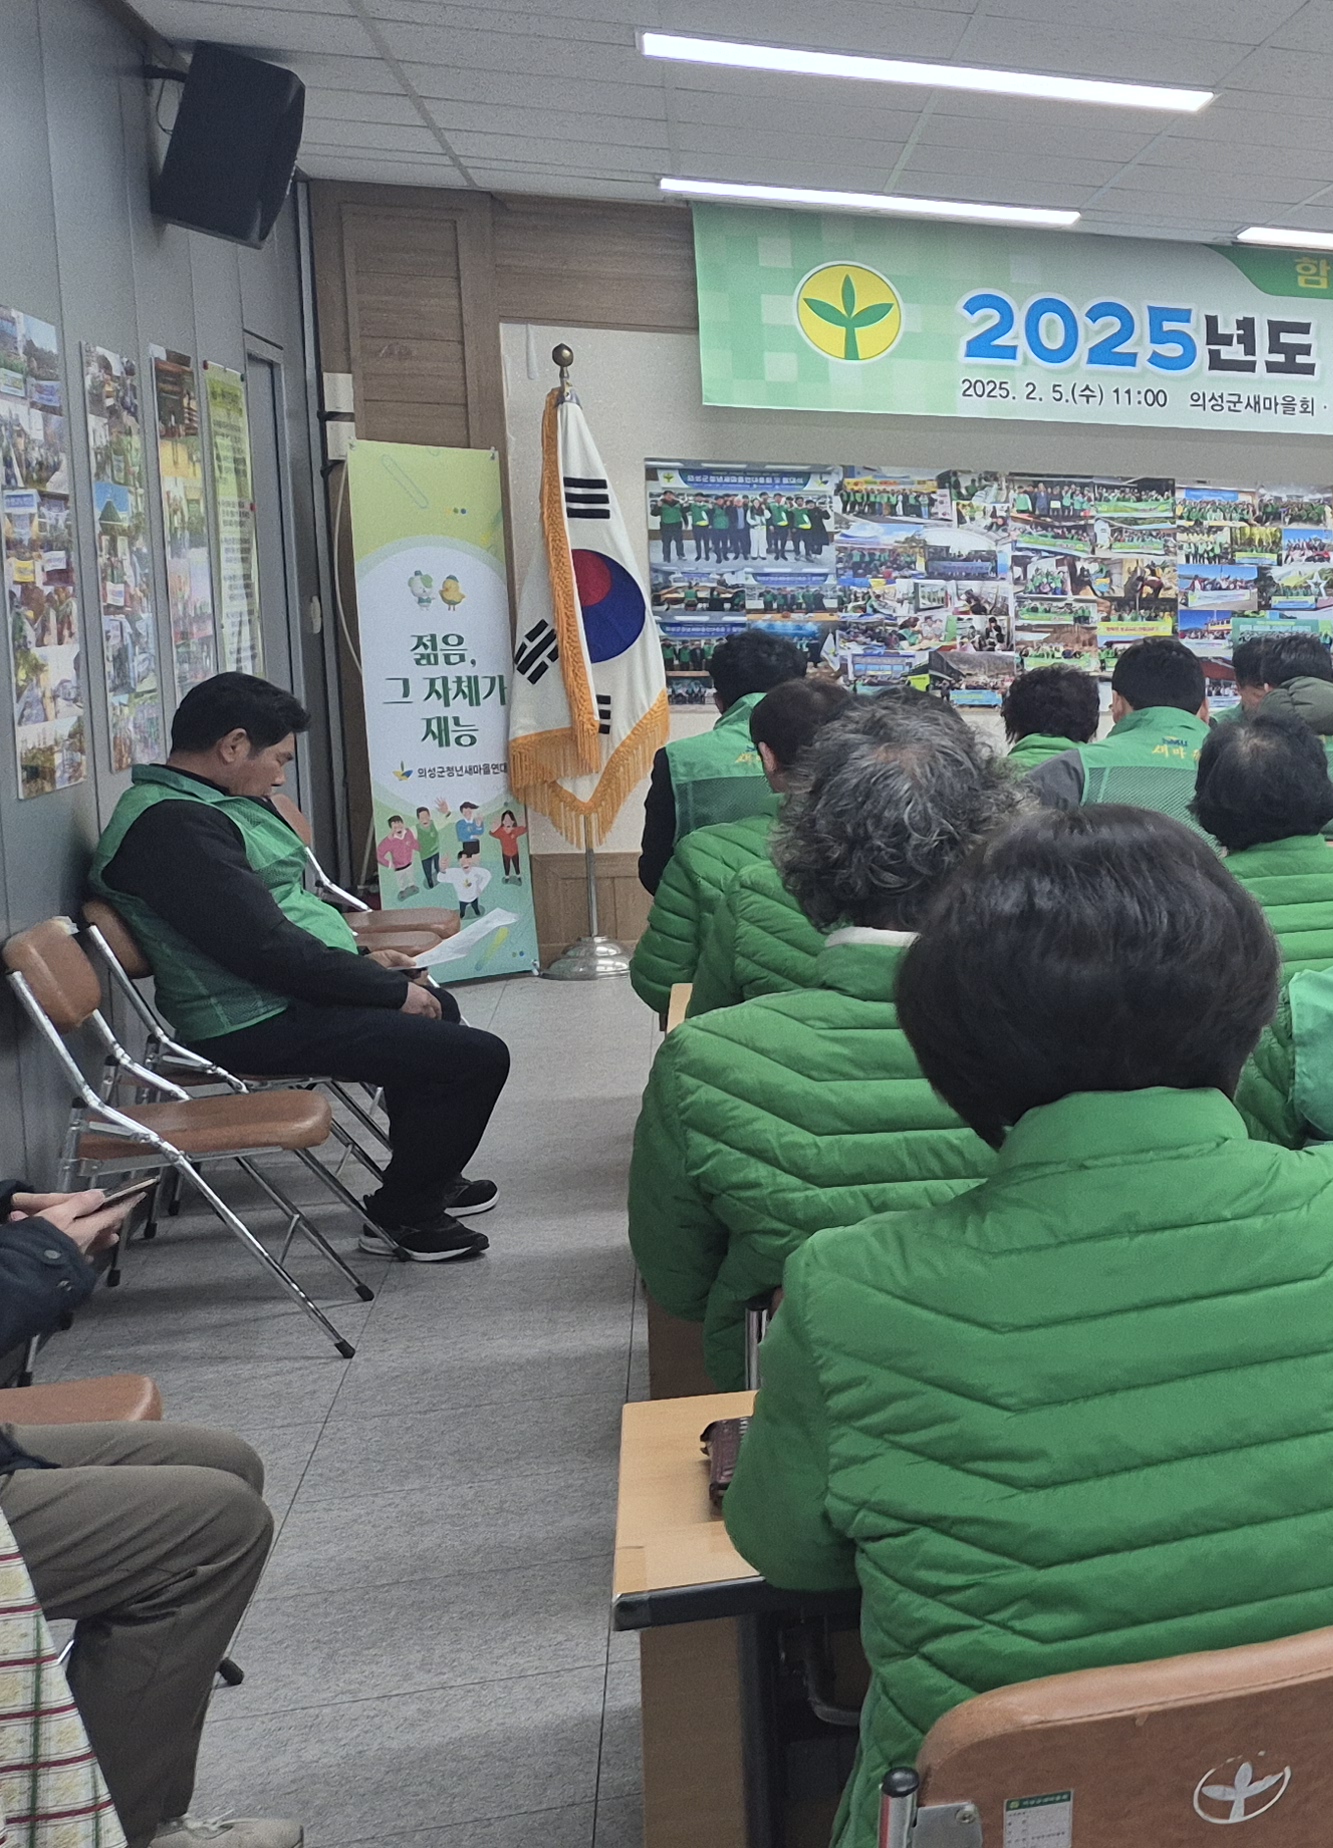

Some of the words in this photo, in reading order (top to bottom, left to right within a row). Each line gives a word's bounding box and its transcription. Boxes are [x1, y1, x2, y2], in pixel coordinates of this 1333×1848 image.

[962, 293, 1316, 376] 2025년도
[961, 378, 1016, 400] 2025.
[1025, 382, 1043, 402] 2.
[1112, 387, 1168, 408] 11:00
[1189, 391, 1315, 416] 의성군새마을회
[410, 633, 477, 668] 젊음,
[383, 677, 413, 704] 그
[423, 674, 507, 708] 자체가
[421, 715, 479, 748] 재능
